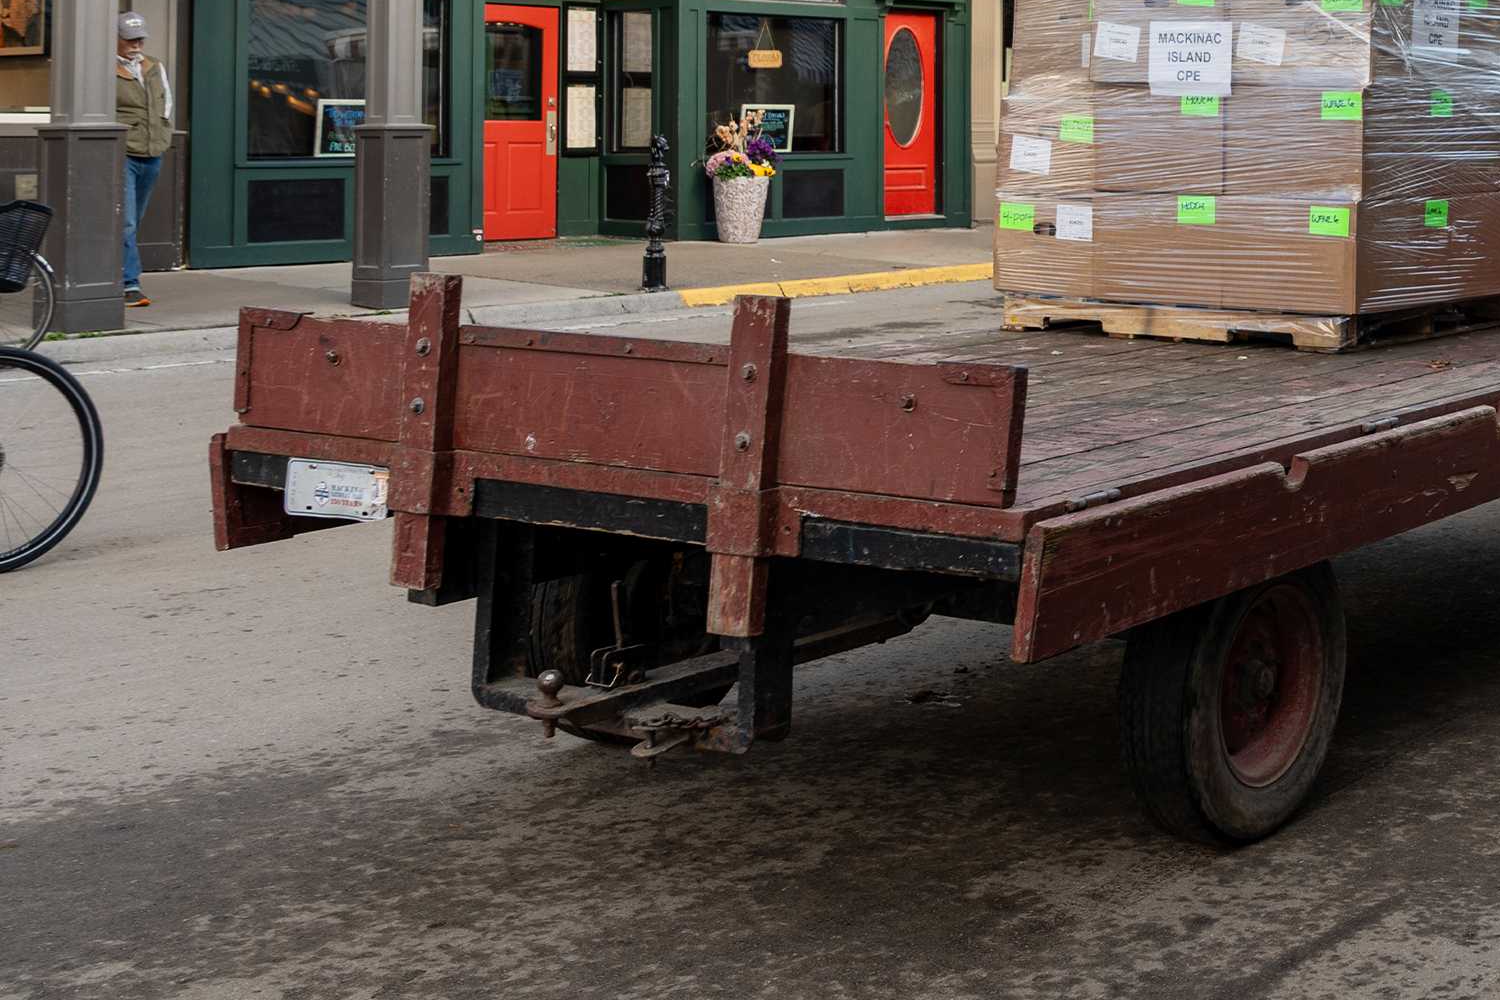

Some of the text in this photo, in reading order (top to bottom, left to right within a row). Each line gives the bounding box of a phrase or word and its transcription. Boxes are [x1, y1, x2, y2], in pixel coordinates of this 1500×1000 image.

[1158, 32, 1222, 44] MACKINAC
[1167, 51, 1211, 63] ISLAND
[1176, 70, 1201, 82] CPE
